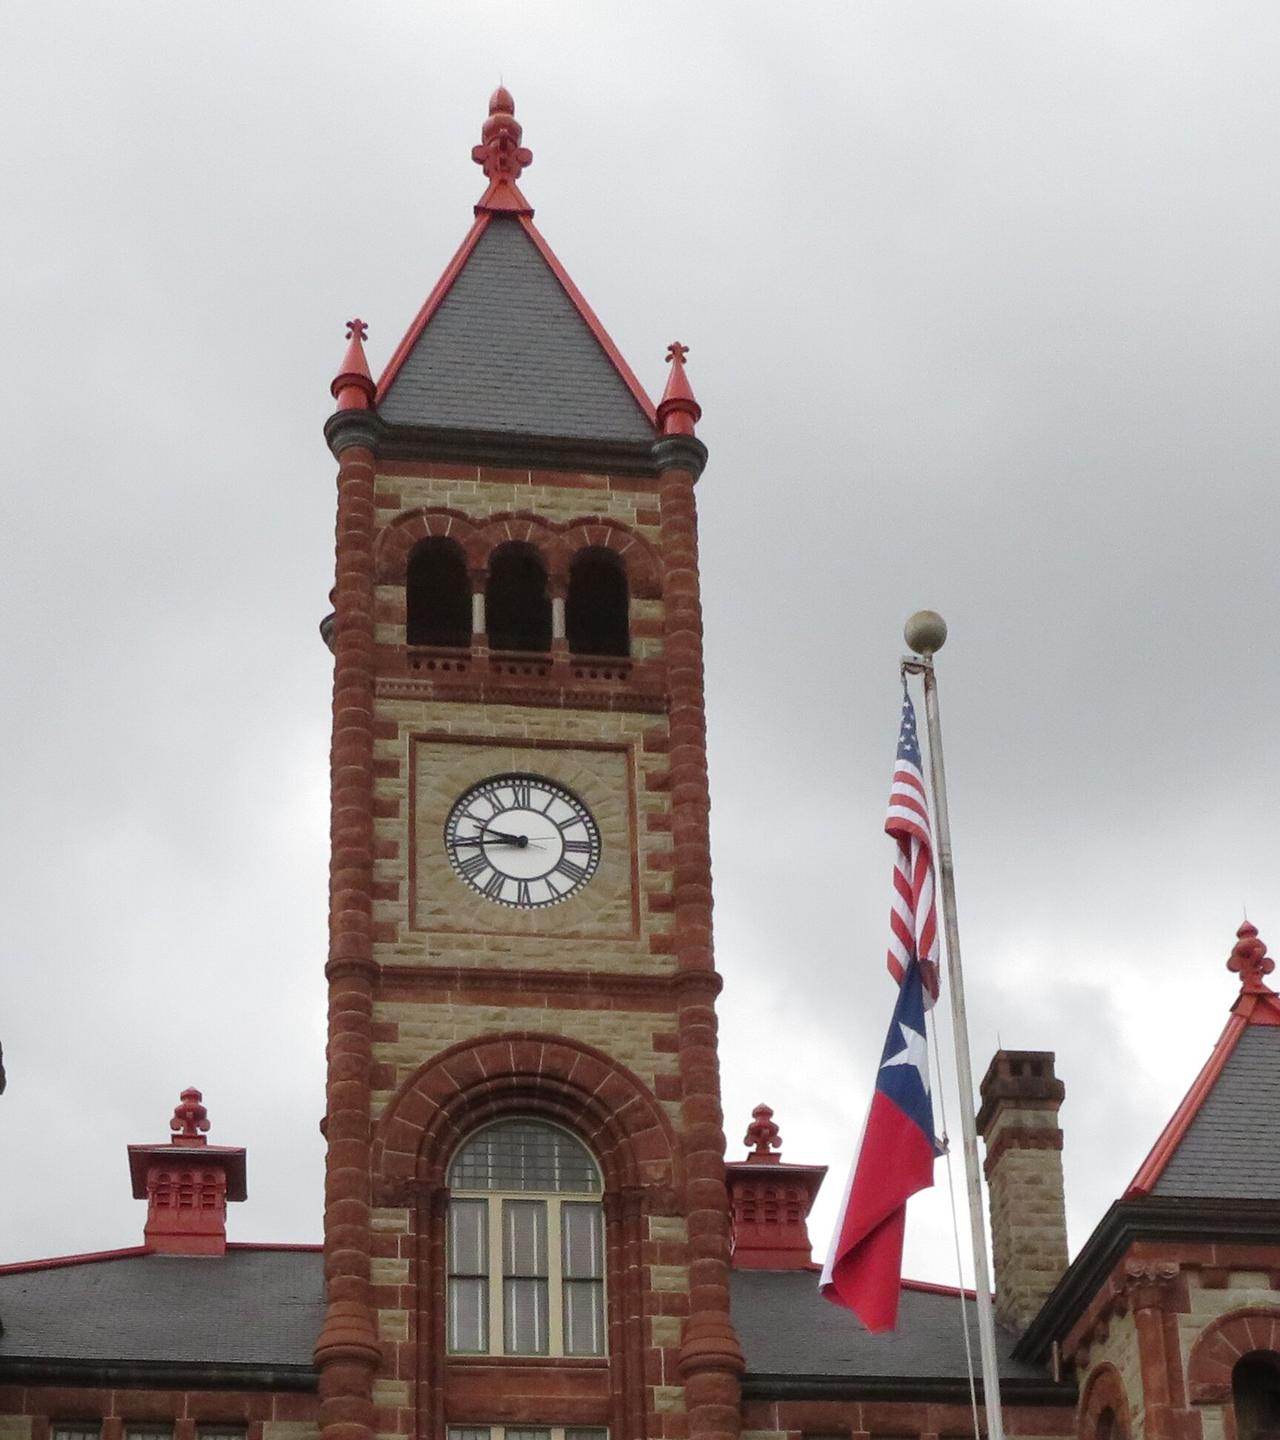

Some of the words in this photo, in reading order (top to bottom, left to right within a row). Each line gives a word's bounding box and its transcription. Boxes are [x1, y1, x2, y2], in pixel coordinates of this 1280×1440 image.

[512, 785, 531, 808] XII
[558, 814, 583, 830] II
[564, 840, 592, 853] III
[517, 881, 532, 904] VI
